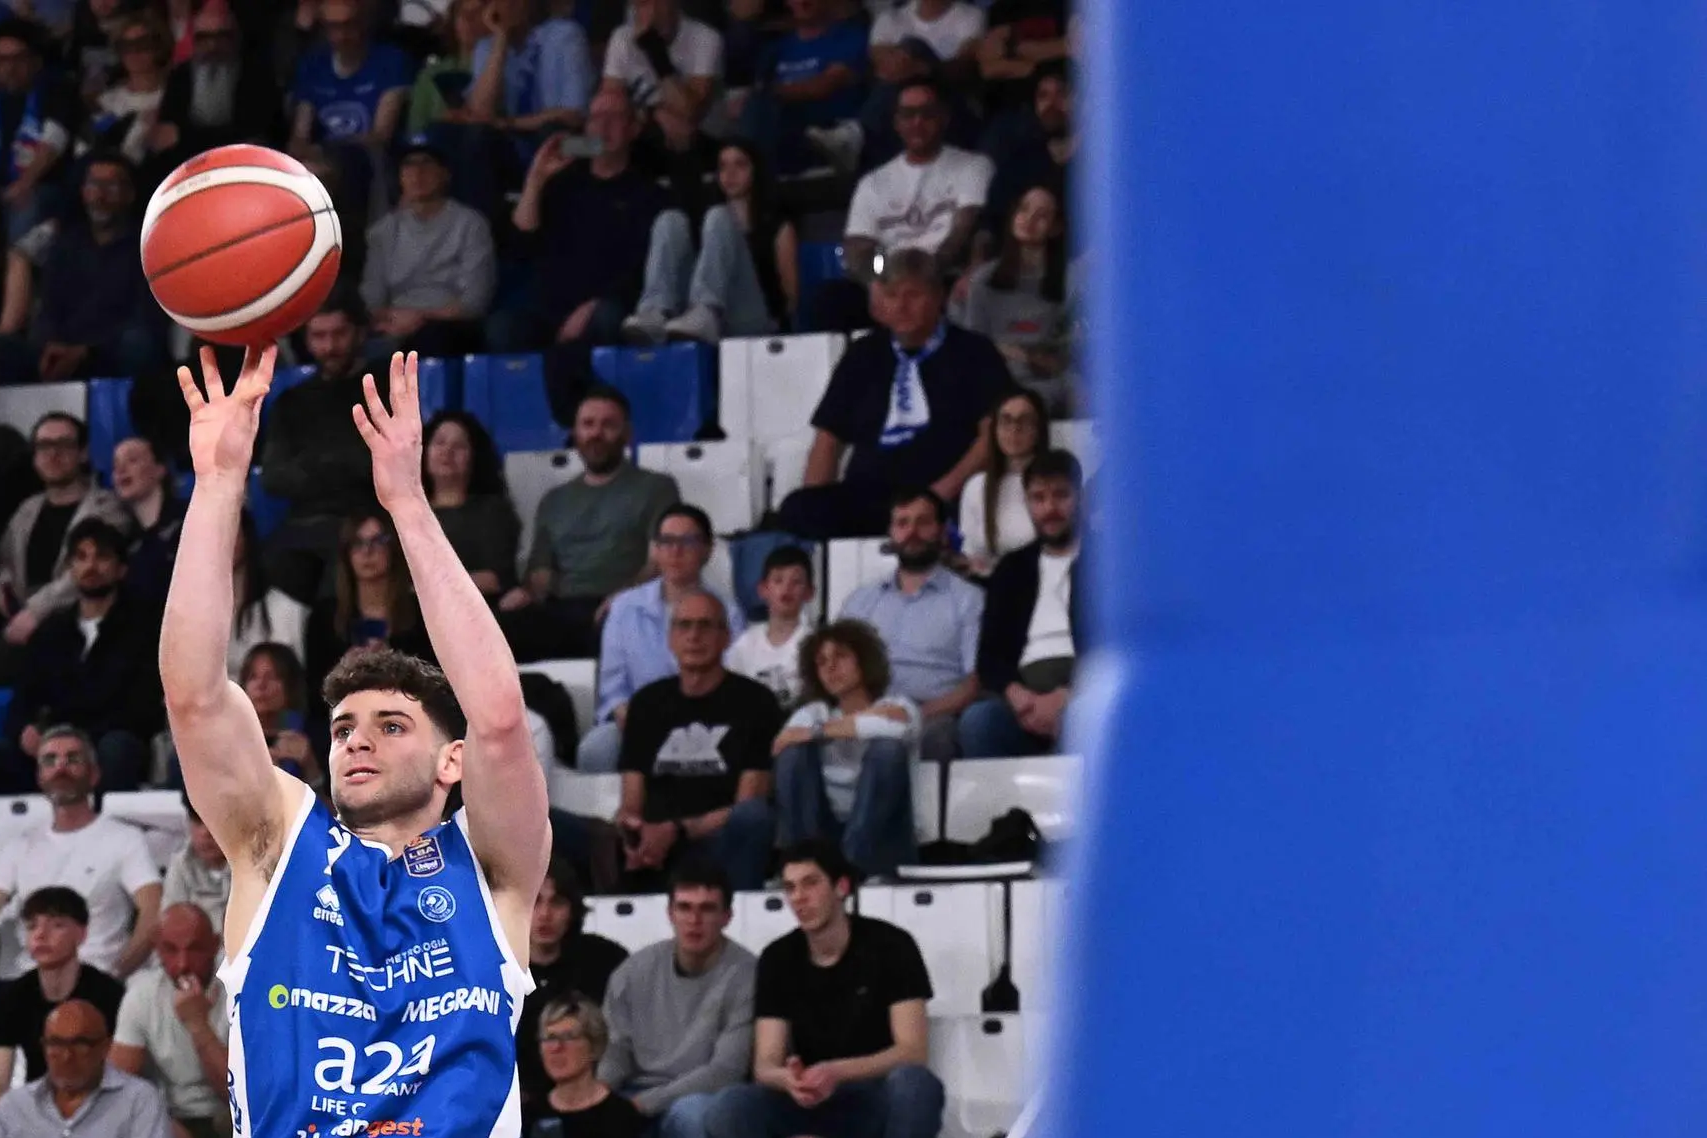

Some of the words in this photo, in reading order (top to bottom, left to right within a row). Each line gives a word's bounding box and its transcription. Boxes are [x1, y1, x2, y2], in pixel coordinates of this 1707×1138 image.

[408, 847, 436, 860] LBA
[386, 938, 448, 965] METROOGIA
[401, 987, 501, 1023] MEGRANI
[314, 1034, 436, 1095] a2a
[311, 1096, 346, 1115] LIFE
